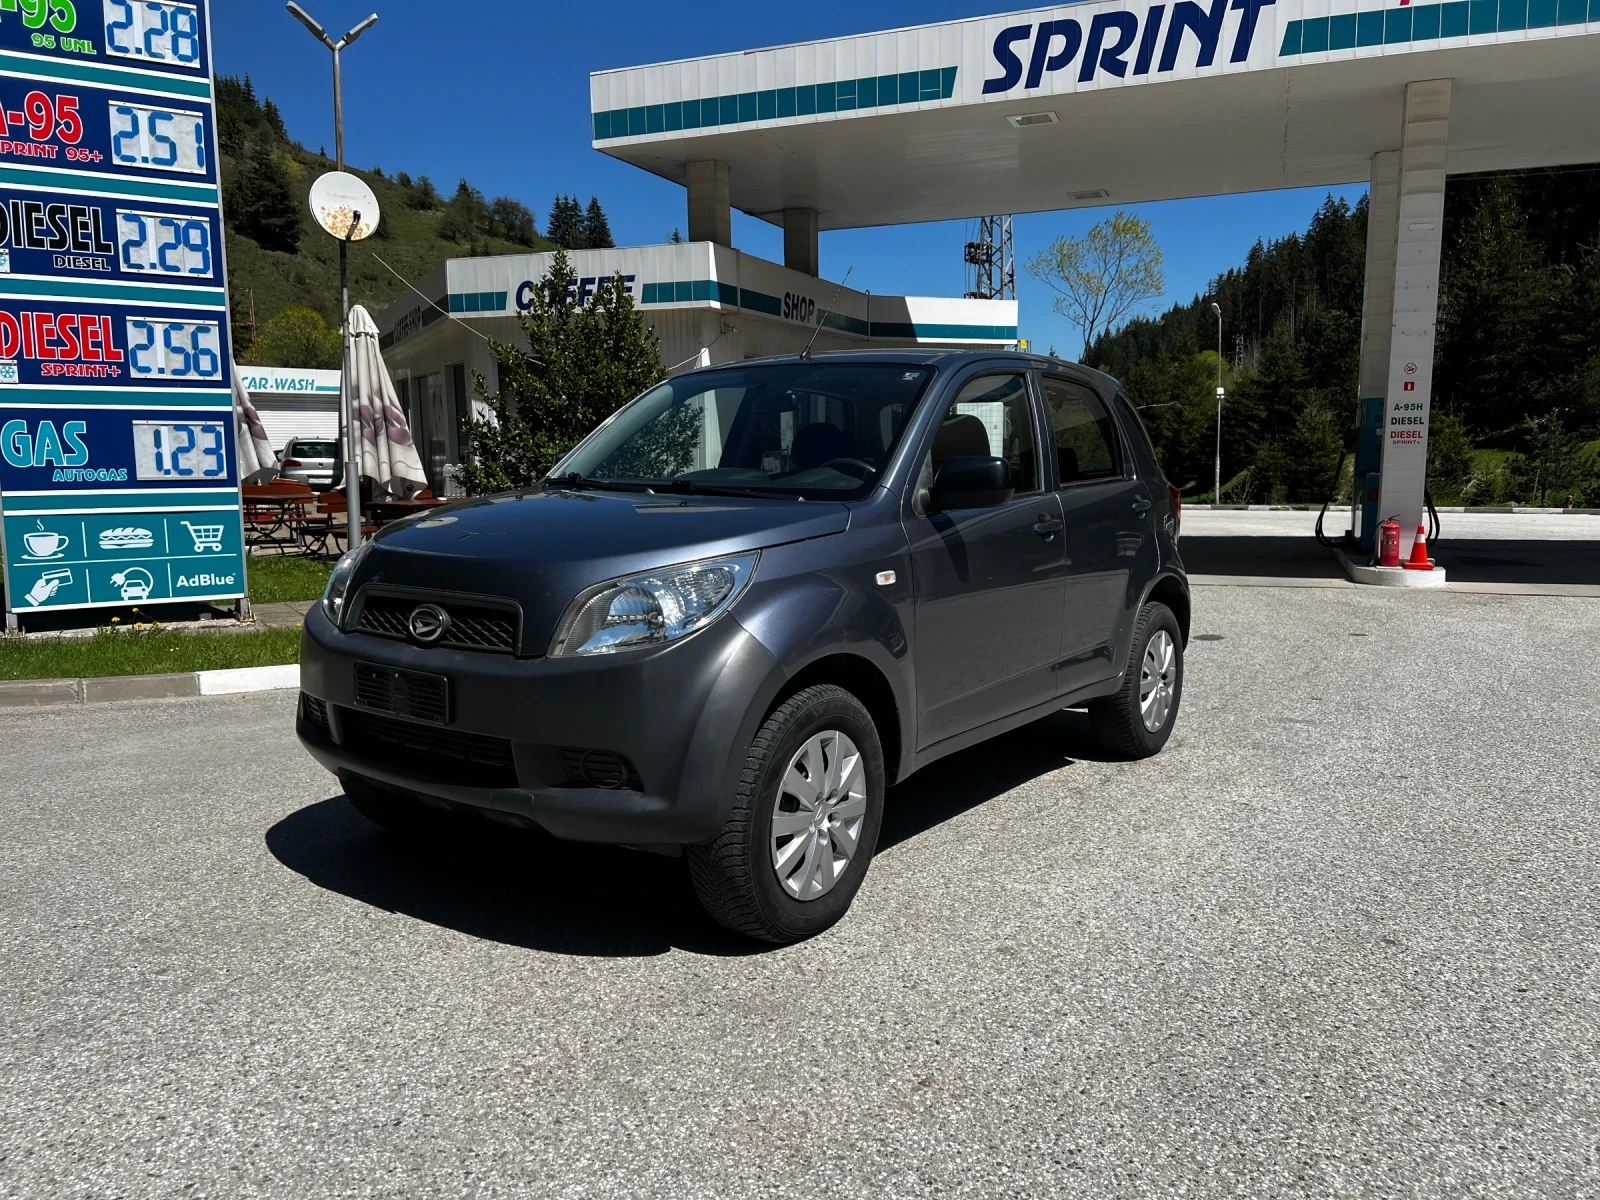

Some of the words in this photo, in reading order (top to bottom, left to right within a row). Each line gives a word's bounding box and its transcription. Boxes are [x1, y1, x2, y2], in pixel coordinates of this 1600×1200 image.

[0, 0, 77, 33] -95
[106, 0, 198, 62] 2.28
[31, 33, 56, 49] 95
[60, 37, 97, 55] UNL
[982, 0, 1276, 94] SPRINT
[0, 90, 83, 145] -95
[0, 140, 58, 158] PRINT
[65, 147, 103, 162] 95+
[113, 106, 205, 168] 2.51
[121, 213, 210, 275] 2.29
[53, 254, 111, 271] DIESEL
[783, 291, 815, 323] SHOP
[0, 310, 124, 361] DIESEL
[130, 320, 219, 376] 2.56
[41, 363, 121, 377] SPRINT+
[1391, 416, 1424, 425] DIESEL
[1393, 403, 1423, 411] A-95H
[0, 419, 89, 468] GAS
[153, 424, 224, 476] 1.23
[1390, 430, 1423, 438] DIESEL
[52, 468, 128, 482] AUTOGAS
[176, 573, 235, 588] AdBlue
